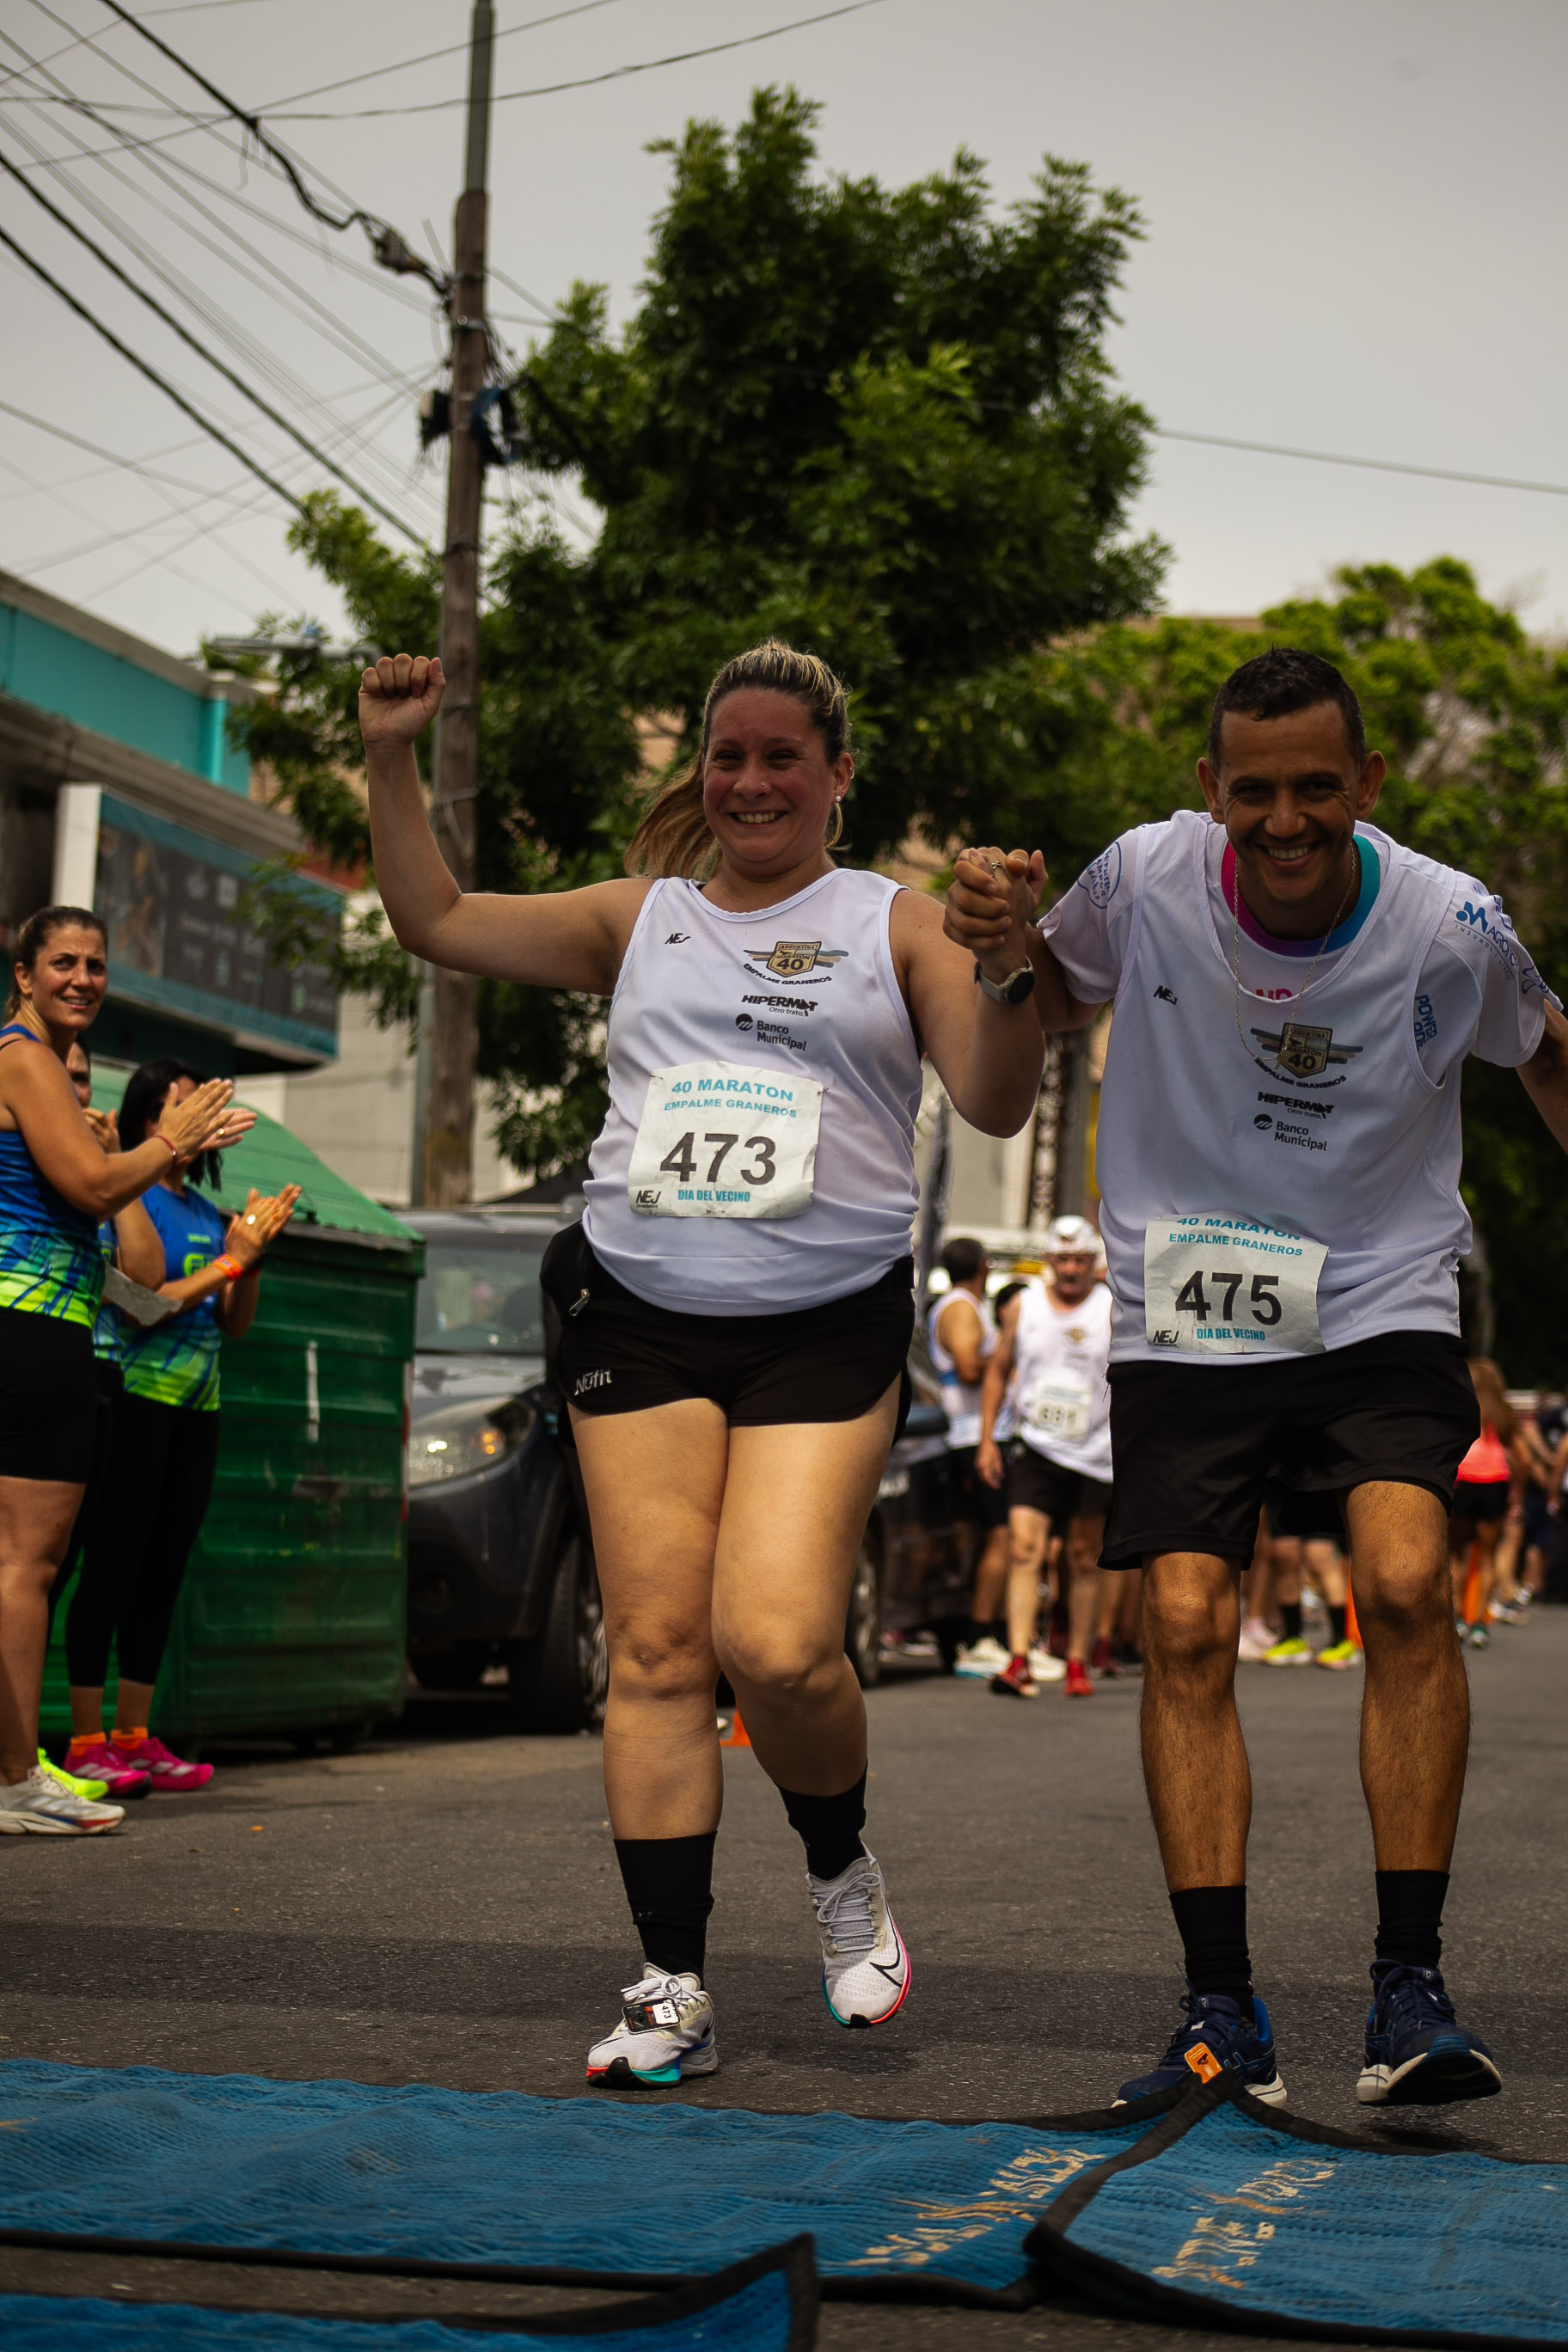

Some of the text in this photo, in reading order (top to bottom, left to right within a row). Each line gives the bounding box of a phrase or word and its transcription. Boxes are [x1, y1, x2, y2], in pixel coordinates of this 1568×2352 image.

[1455, 924, 1493, 952] INSUMOS
[743, 963, 833, 985] EMPALME GRANEROS
[776, 959, 805, 971] 40
[741, 995, 818, 1013] HIPERMAT
[1153, 985, 1179, 1006] NEJ
[756, 1020, 790, 1035] Banco
[1414, 995, 1438, 1042] POWER
[756, 1032, 807, 1051] Municipal
[1289, 1053, 1316, 1069] 40
[1254, 1058, 1347, 1088] EMPALME GRANEROS
[671, 1079, 793, 1101] 40 MARATON
[664, 1099, 797, 1118] EMPALME GRANEROS
[1257, 1091, 1335, 1114] HIPERMAT
[1276, 1121, 1309, 1136] Banco
[1274, 1131, 1328, 1152] Municipal
[659, 1131, 776, 1185] 473
[636, 1190, 661, 1204] NEJ
[678, 1190, 750, 1202] DIA DEL VECINO
[1176, 1217, 1302, 1241] 40 MARATON
[1169, 1233, 1303, 1256] EMPALME GRANEROS
[1175, 1270, 1283, 1326] 475
[1153, 1330, 1179, 1344] NEJ
[1197, 1327, 1265, 1341] DIA DEL VECINO
[662, 2006, 672, 2019] 473
